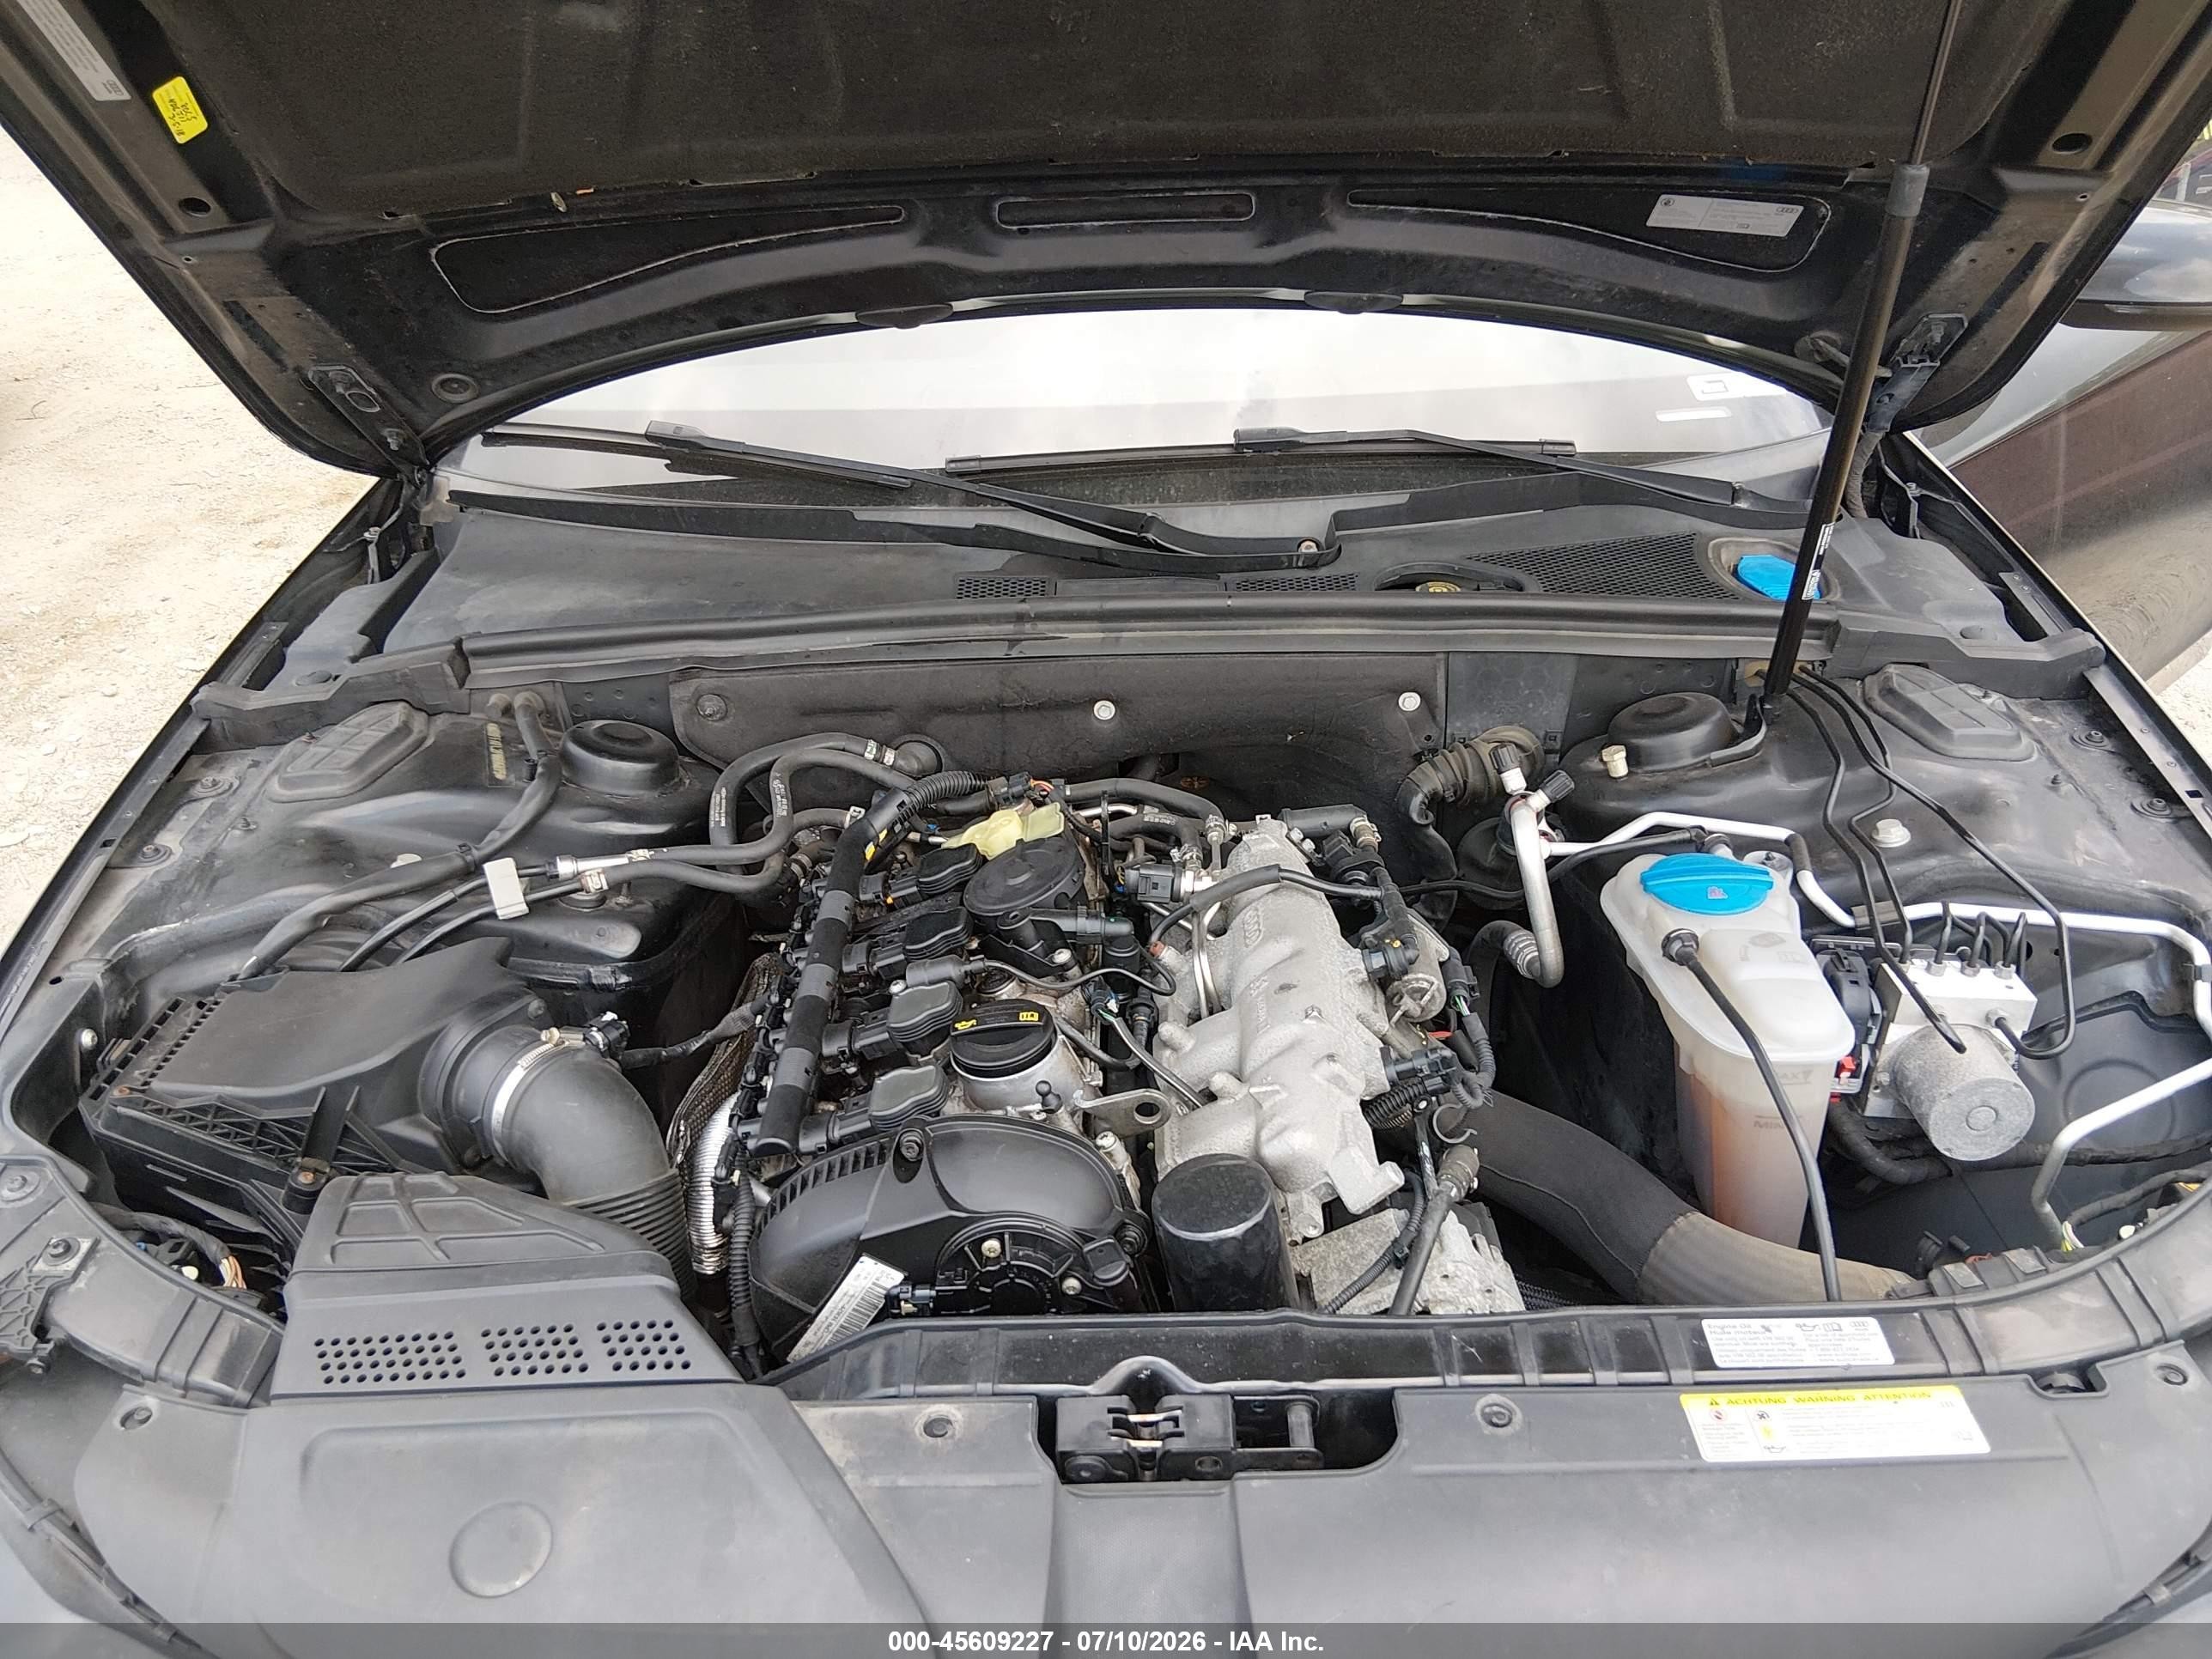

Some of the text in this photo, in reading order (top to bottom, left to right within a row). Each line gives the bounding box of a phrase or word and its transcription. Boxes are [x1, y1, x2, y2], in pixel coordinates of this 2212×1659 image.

[1726, 1392, 1931, 1406] ACHTUNG WARNING ATTENTION
